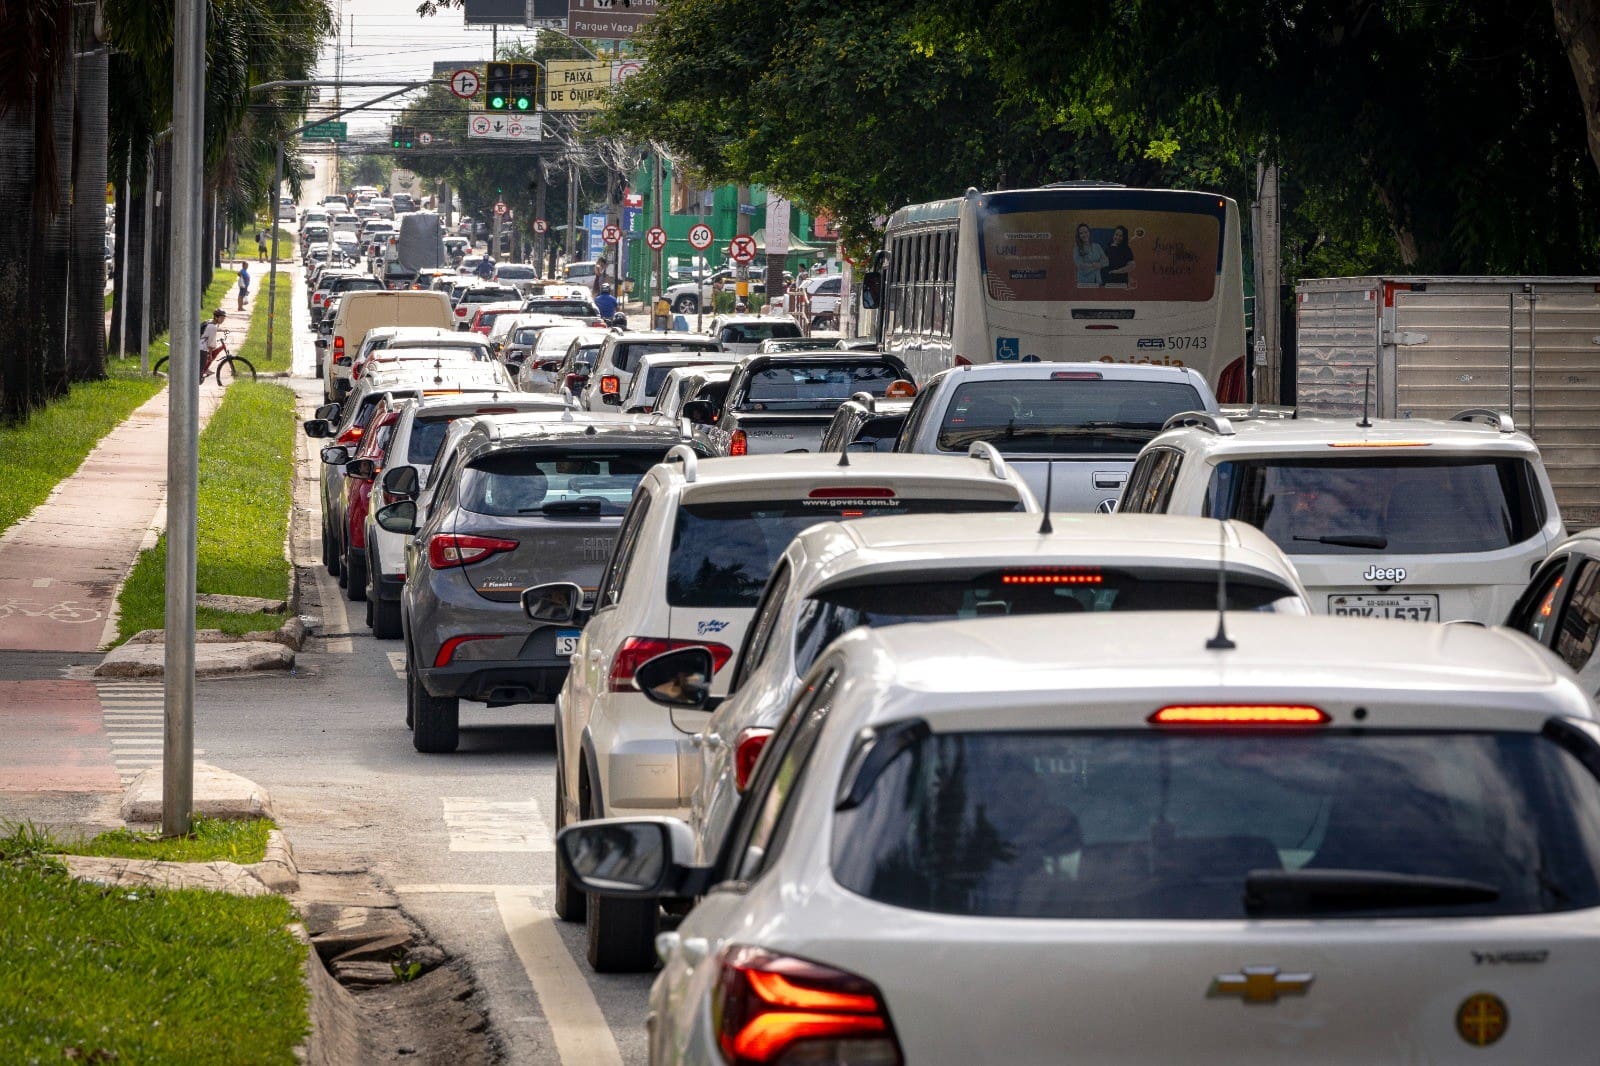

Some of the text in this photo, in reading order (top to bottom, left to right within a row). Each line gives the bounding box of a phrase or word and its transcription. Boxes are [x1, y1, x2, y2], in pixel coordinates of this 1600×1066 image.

[575, 21, 609, 32] Parque
[611, 23, 634, 32] Vaca
[564, 71, 593, 83] FAIXA
[550, 90, 564, 101] DE
[693, 229, 709, 241] 60
[1168, 336, 1208, 350] 50743
[801, 498, 901, 507] www.govesa.com.br
[1364, 565, 1406, 582] Jeep
